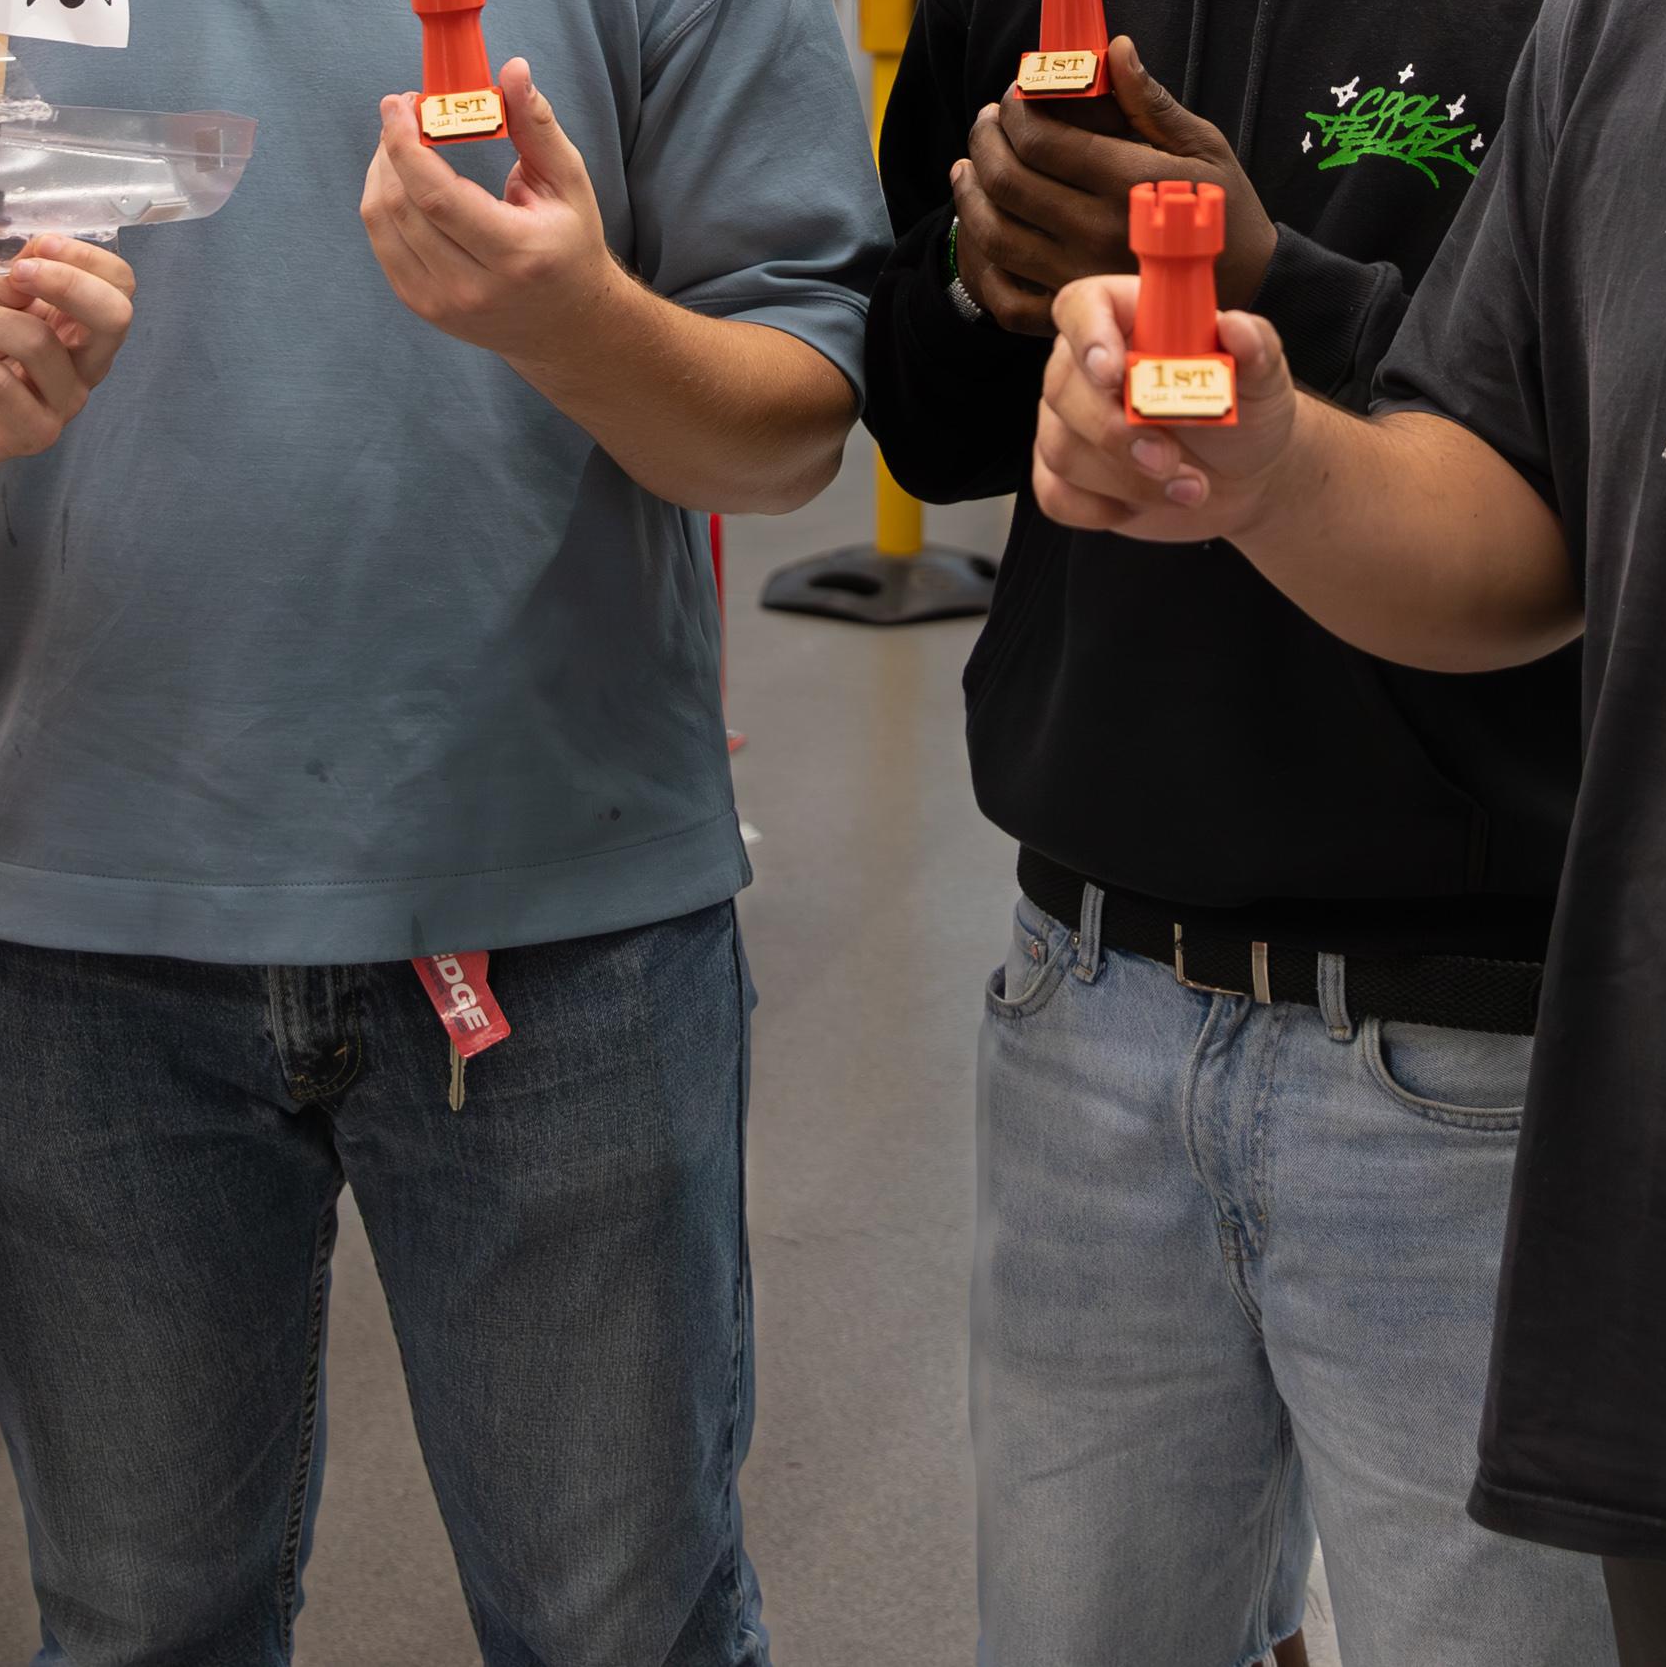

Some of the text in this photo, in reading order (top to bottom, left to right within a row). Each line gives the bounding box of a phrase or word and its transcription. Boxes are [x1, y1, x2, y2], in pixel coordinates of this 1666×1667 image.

[1033, 56, 1085, 73] 1ST
[436, 97, 487, 117] 1ST
[1150, 364, 1215, 389] 1ST
[433, 954, 490, 1031] DGE
